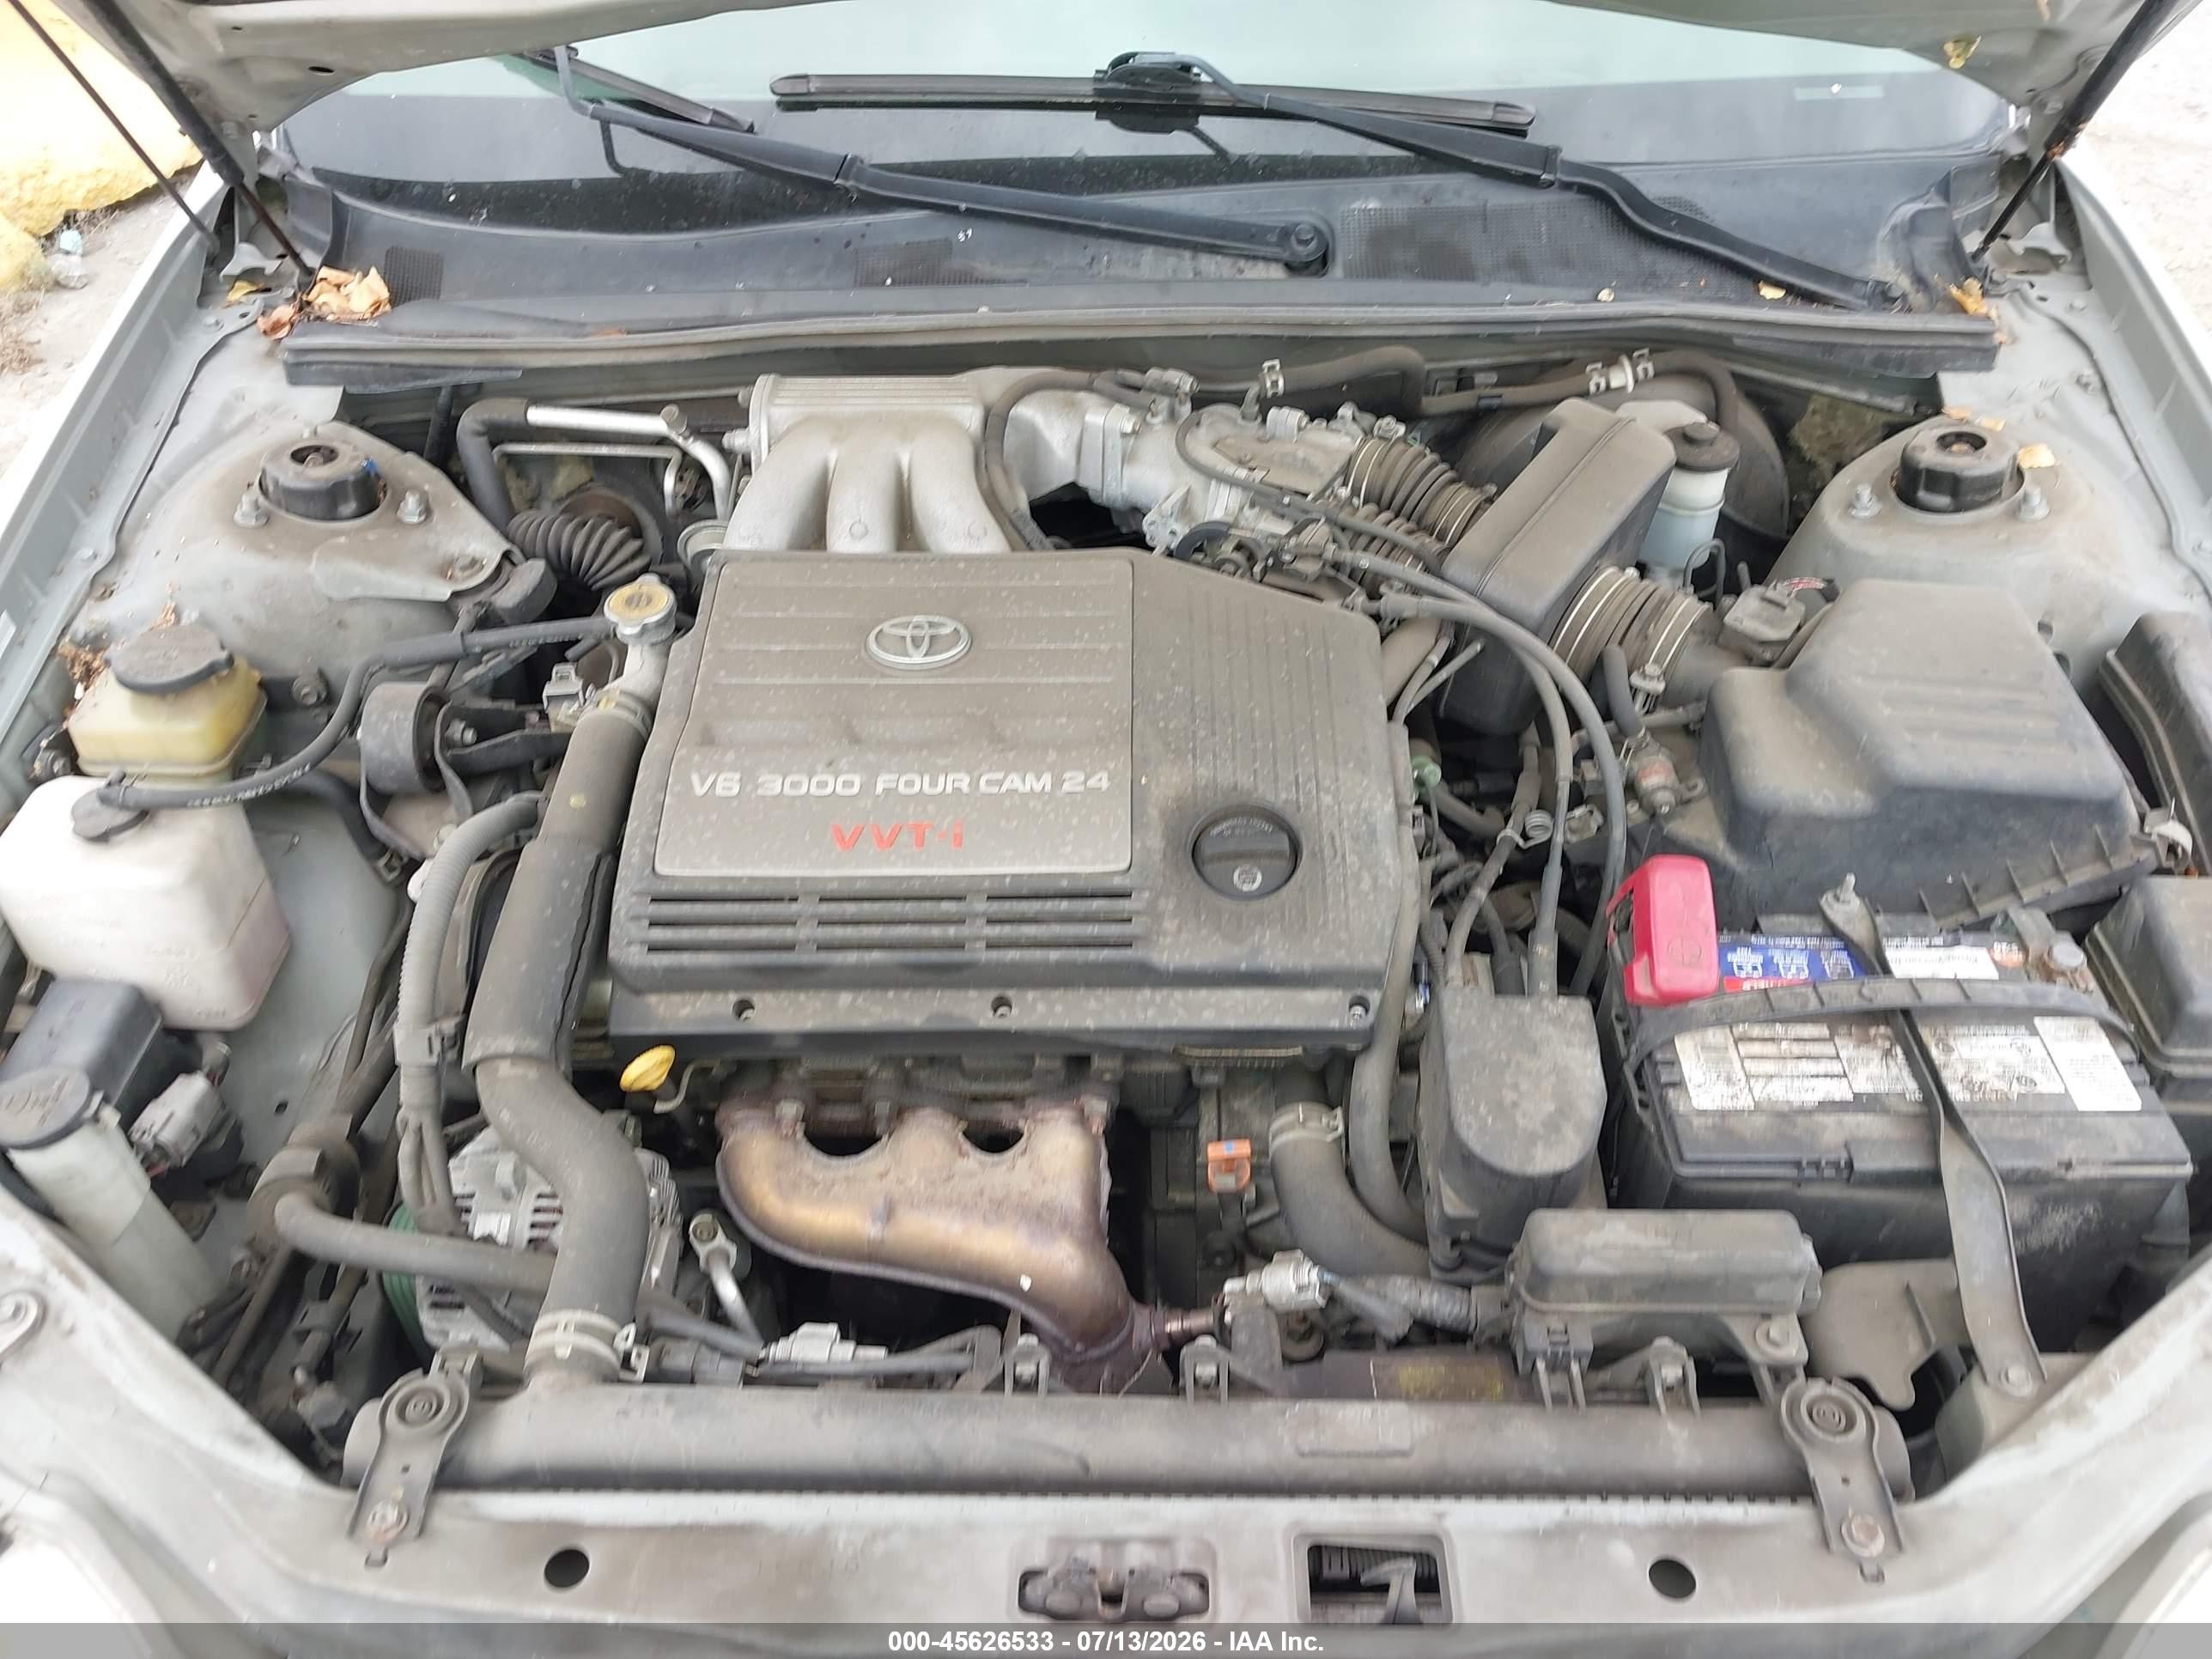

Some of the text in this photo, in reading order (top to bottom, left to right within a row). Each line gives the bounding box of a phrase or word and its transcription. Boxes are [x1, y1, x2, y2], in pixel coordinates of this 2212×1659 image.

[690, 769, 1111, 798] V6 3000 FOUR CAM 24
[831, 819, 963, 853] VVT-i
